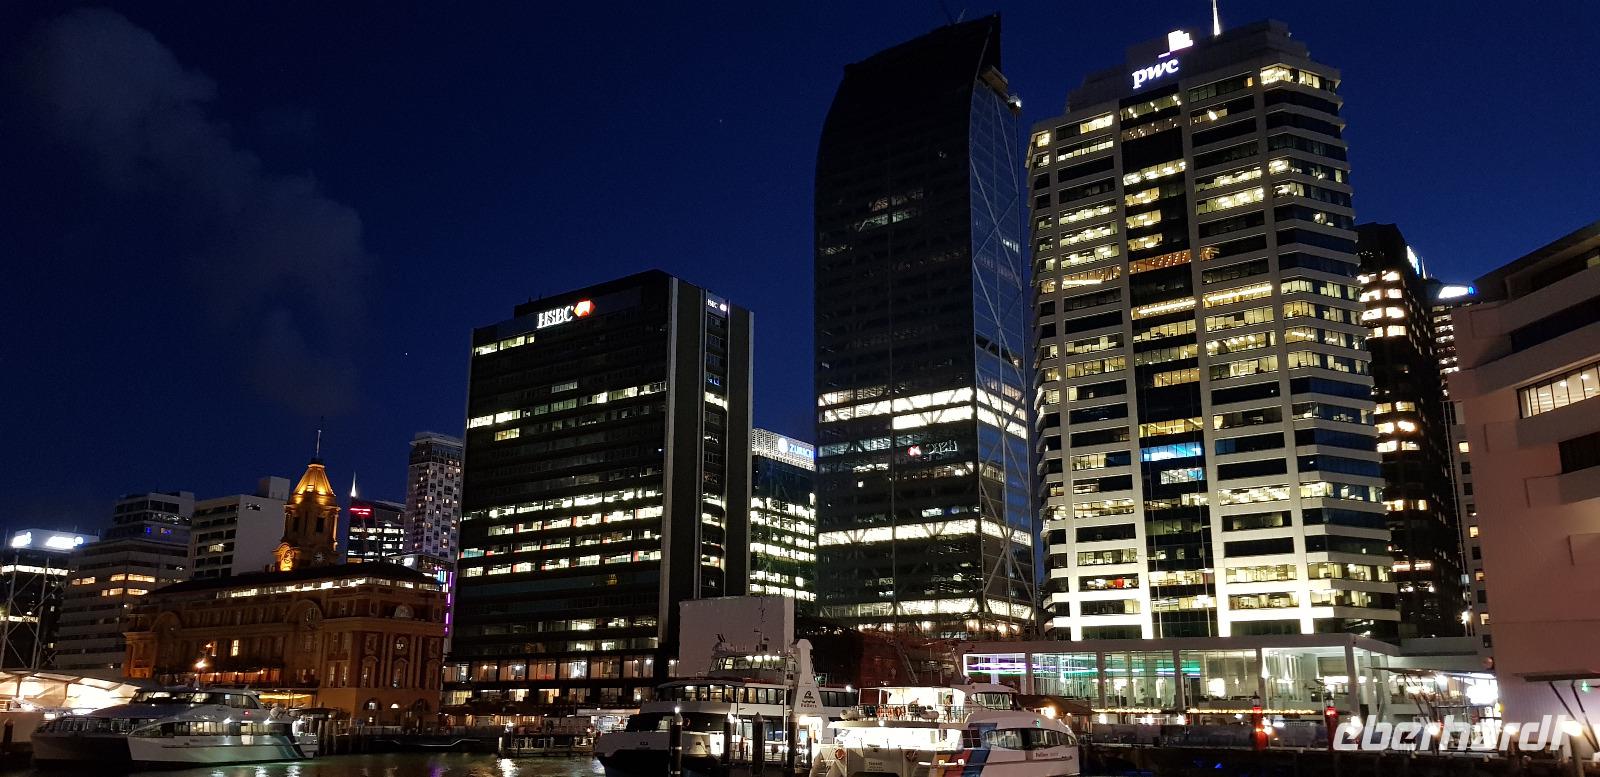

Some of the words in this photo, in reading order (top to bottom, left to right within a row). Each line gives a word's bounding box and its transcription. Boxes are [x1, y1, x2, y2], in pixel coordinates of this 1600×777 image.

[1132, 59, 1179, 89] pwc
[537, 306, 574, 328] HSBC
[789, 444, 814, 460] ZURICH
